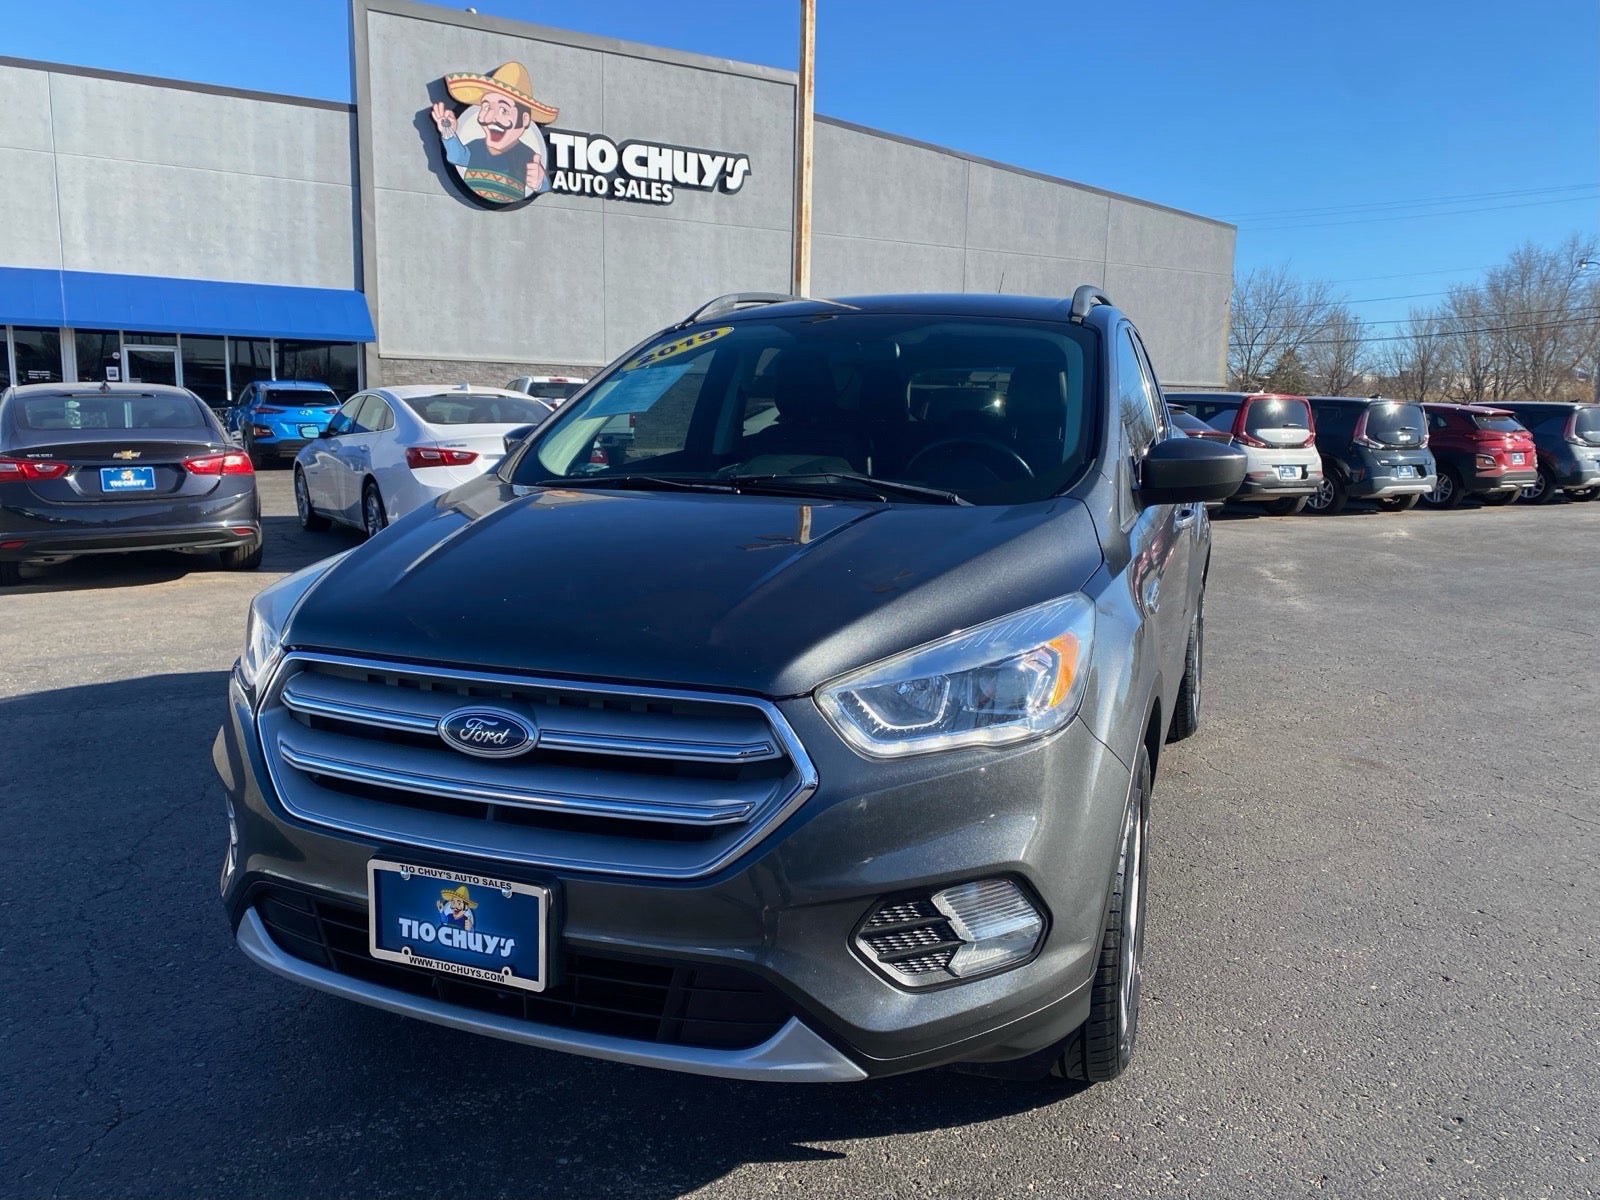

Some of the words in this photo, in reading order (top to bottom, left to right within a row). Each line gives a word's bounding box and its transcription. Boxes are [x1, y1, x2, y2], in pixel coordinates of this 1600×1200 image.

[549, 132, 618, 174] TIO
[621, 144, 750, 191] CHUY'S
[552, 170, 608, 195] AUTO
[613, 179, 674, 203] SALES
[636, 329, 719, 366] 2019
[459, 717, 511, 745] Ford
[400, 864, 415, 873] TIO
[418, 867, 452, 880] CHUY'S
[454, 873, 480, 884] AUTO
[482, 878, 512, 890] SALES
[398, 917, 437, 942] TIO
[437, 926, 516, 958] CHUY'S
[409, 956, 505, 983] WWW.TIOCHUYS.COM
